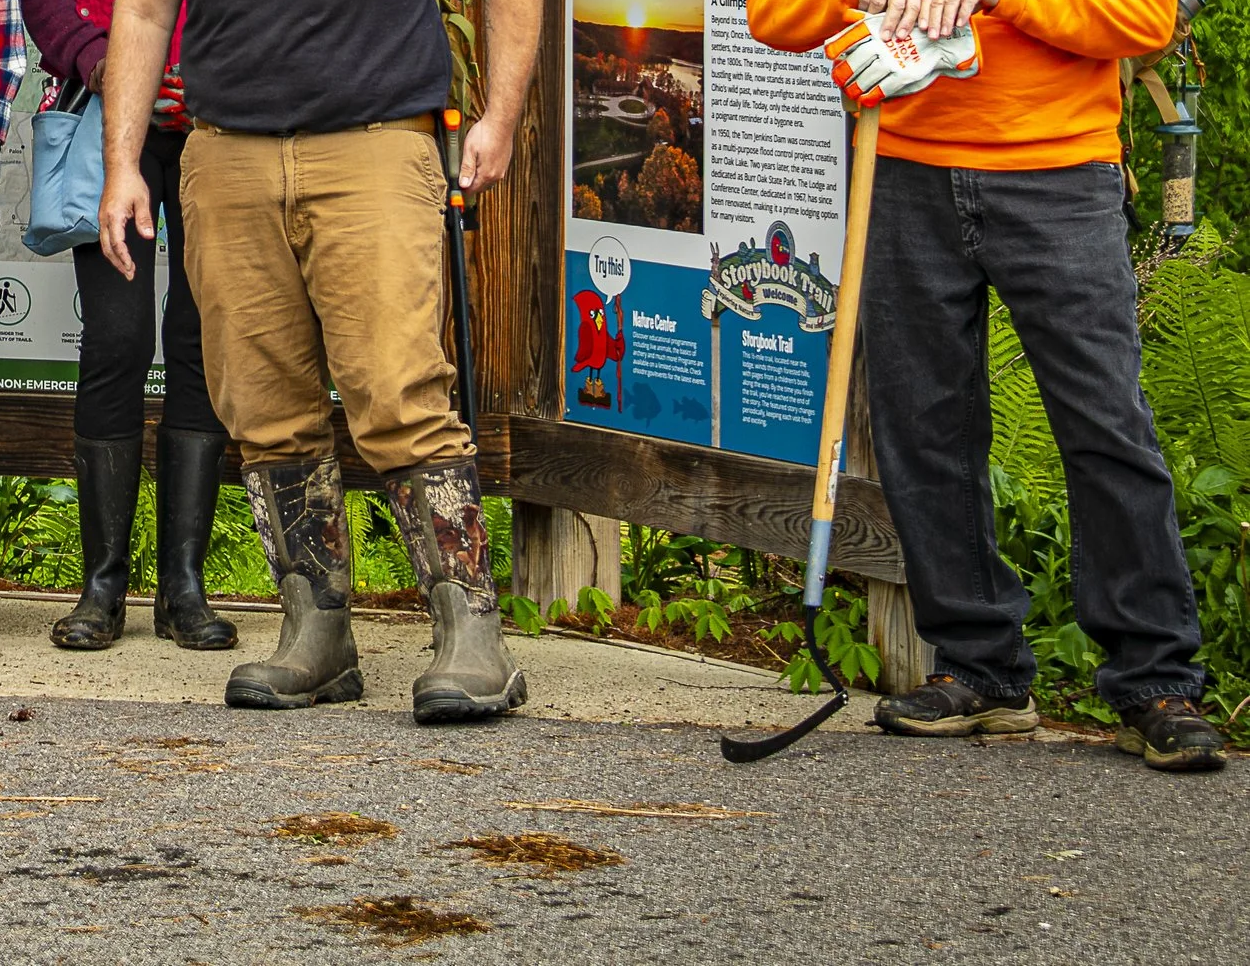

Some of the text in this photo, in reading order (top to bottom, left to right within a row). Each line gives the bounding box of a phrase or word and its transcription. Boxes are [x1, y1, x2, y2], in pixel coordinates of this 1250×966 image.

[715, 110, 738, 124] poignant
[738, 113, 762, 124] reminder
[773, 116, 793, 129] bygone
[793, 119, 803, 128] era.
[710, 127, 831, 149] In 1950, the Tom Jenkins Dam was constructed
[710, 168, 837, 193] dedicated as Burr Oak State Park. The Lodge and
[710, 208, 754, 224] for many visitors.
[594, 255, 624, 278] Try this!
[721, 258, 833, 313] Storybook Trail
[763, 289, 798, 306] Welcome
[632, 310, 677, 332] Nature Center
[742, 330, 794, 353] Storybook Trail
